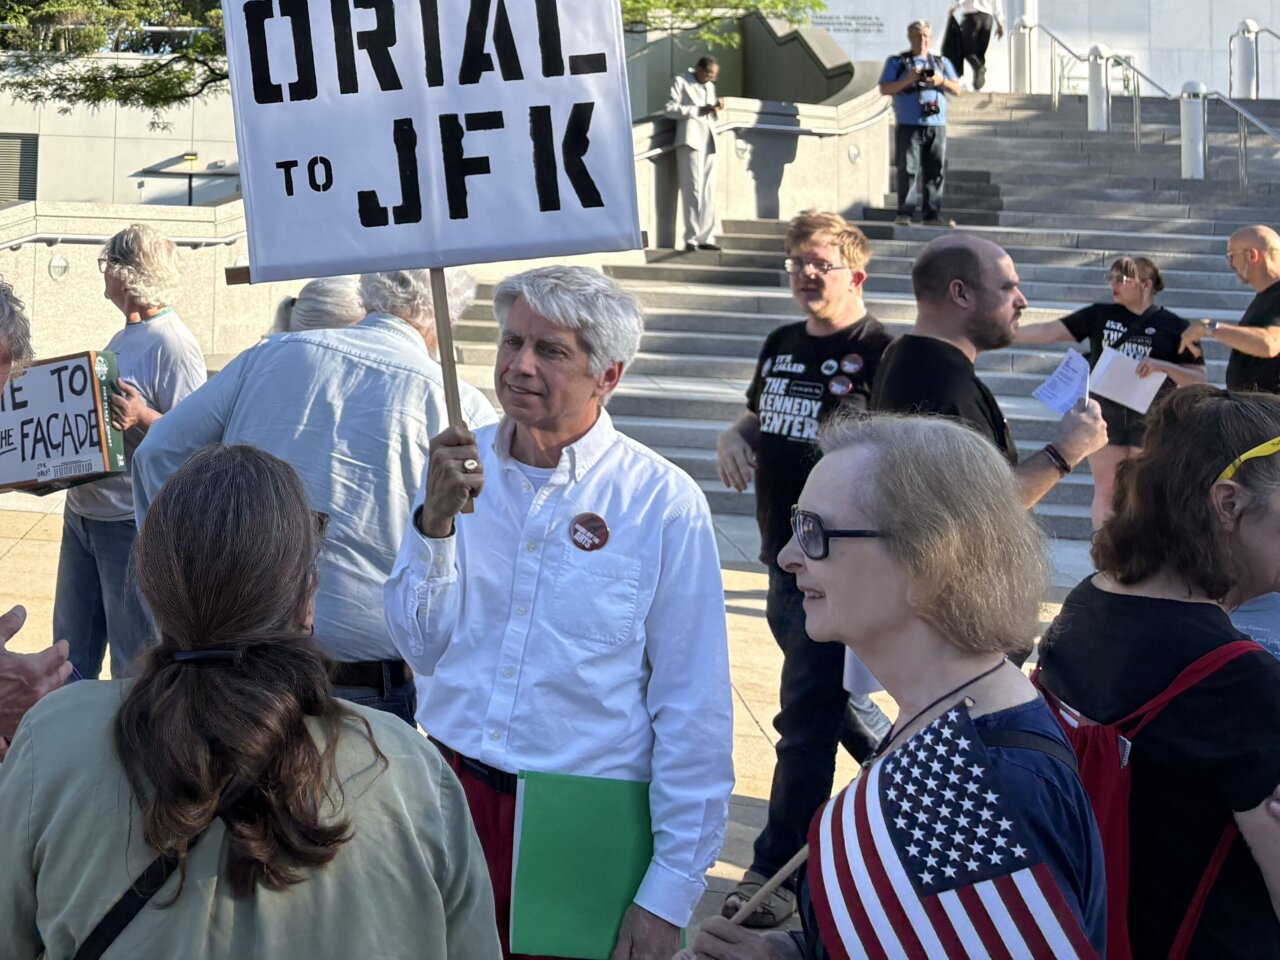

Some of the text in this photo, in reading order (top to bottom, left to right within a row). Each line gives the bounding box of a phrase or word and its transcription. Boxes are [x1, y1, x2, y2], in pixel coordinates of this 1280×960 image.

[275, 101, 605, 227] TO JFK
[50, 363, 88, 403] TO
[763, 377, 789, 394] THE
[759, 393, 822, 419] KENNEDY
